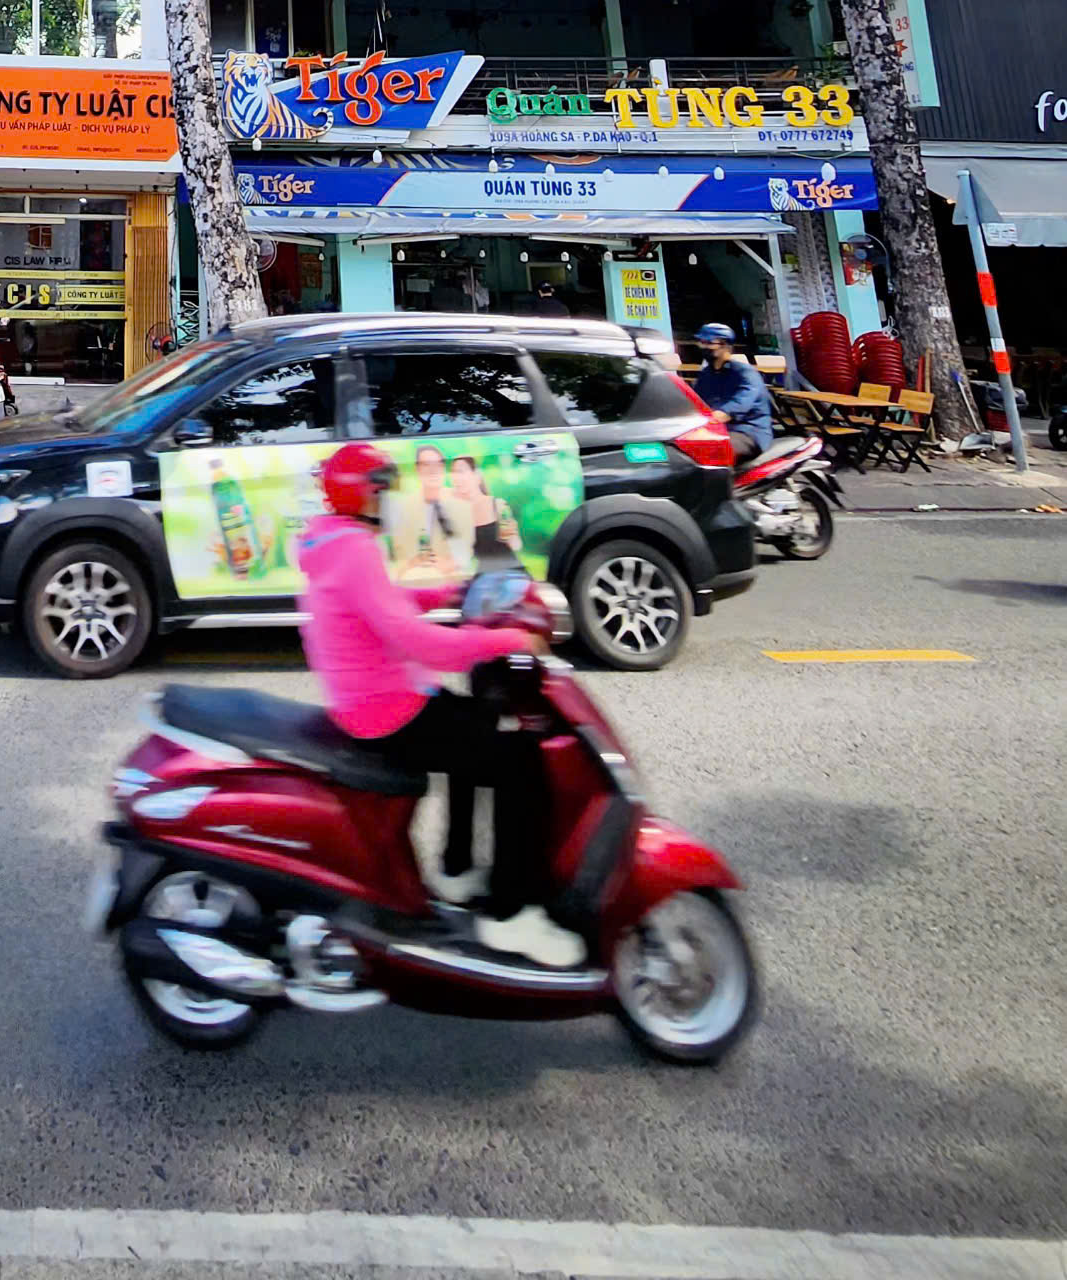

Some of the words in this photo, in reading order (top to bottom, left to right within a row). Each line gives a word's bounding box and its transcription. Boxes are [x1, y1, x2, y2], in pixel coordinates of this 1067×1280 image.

[286, 50, 445, 126] Tiger
[39, 91, 71, 116] TY
[76, 88, 136, 121] LUẬT
[486, 85, 592, 124] Quán
[782, 84, 855, 127] 33
[562, 131, 574, 142] SA
[610, 131, 631, 142] KAO
[781, 130, 807, 141] 0777
[811, 130, 853, 141] 672749
[259, 171, 315, 202] Tiger
[484, 176, 525, 196] QUÁN
[530, 176, 572, 196] TÙNG
[577, 181, 596, 196] 33
[793, 178, 854, 209] Tiger
[4, 255, 21, 265] CIS
[23, 256, 45, 265] LAW
